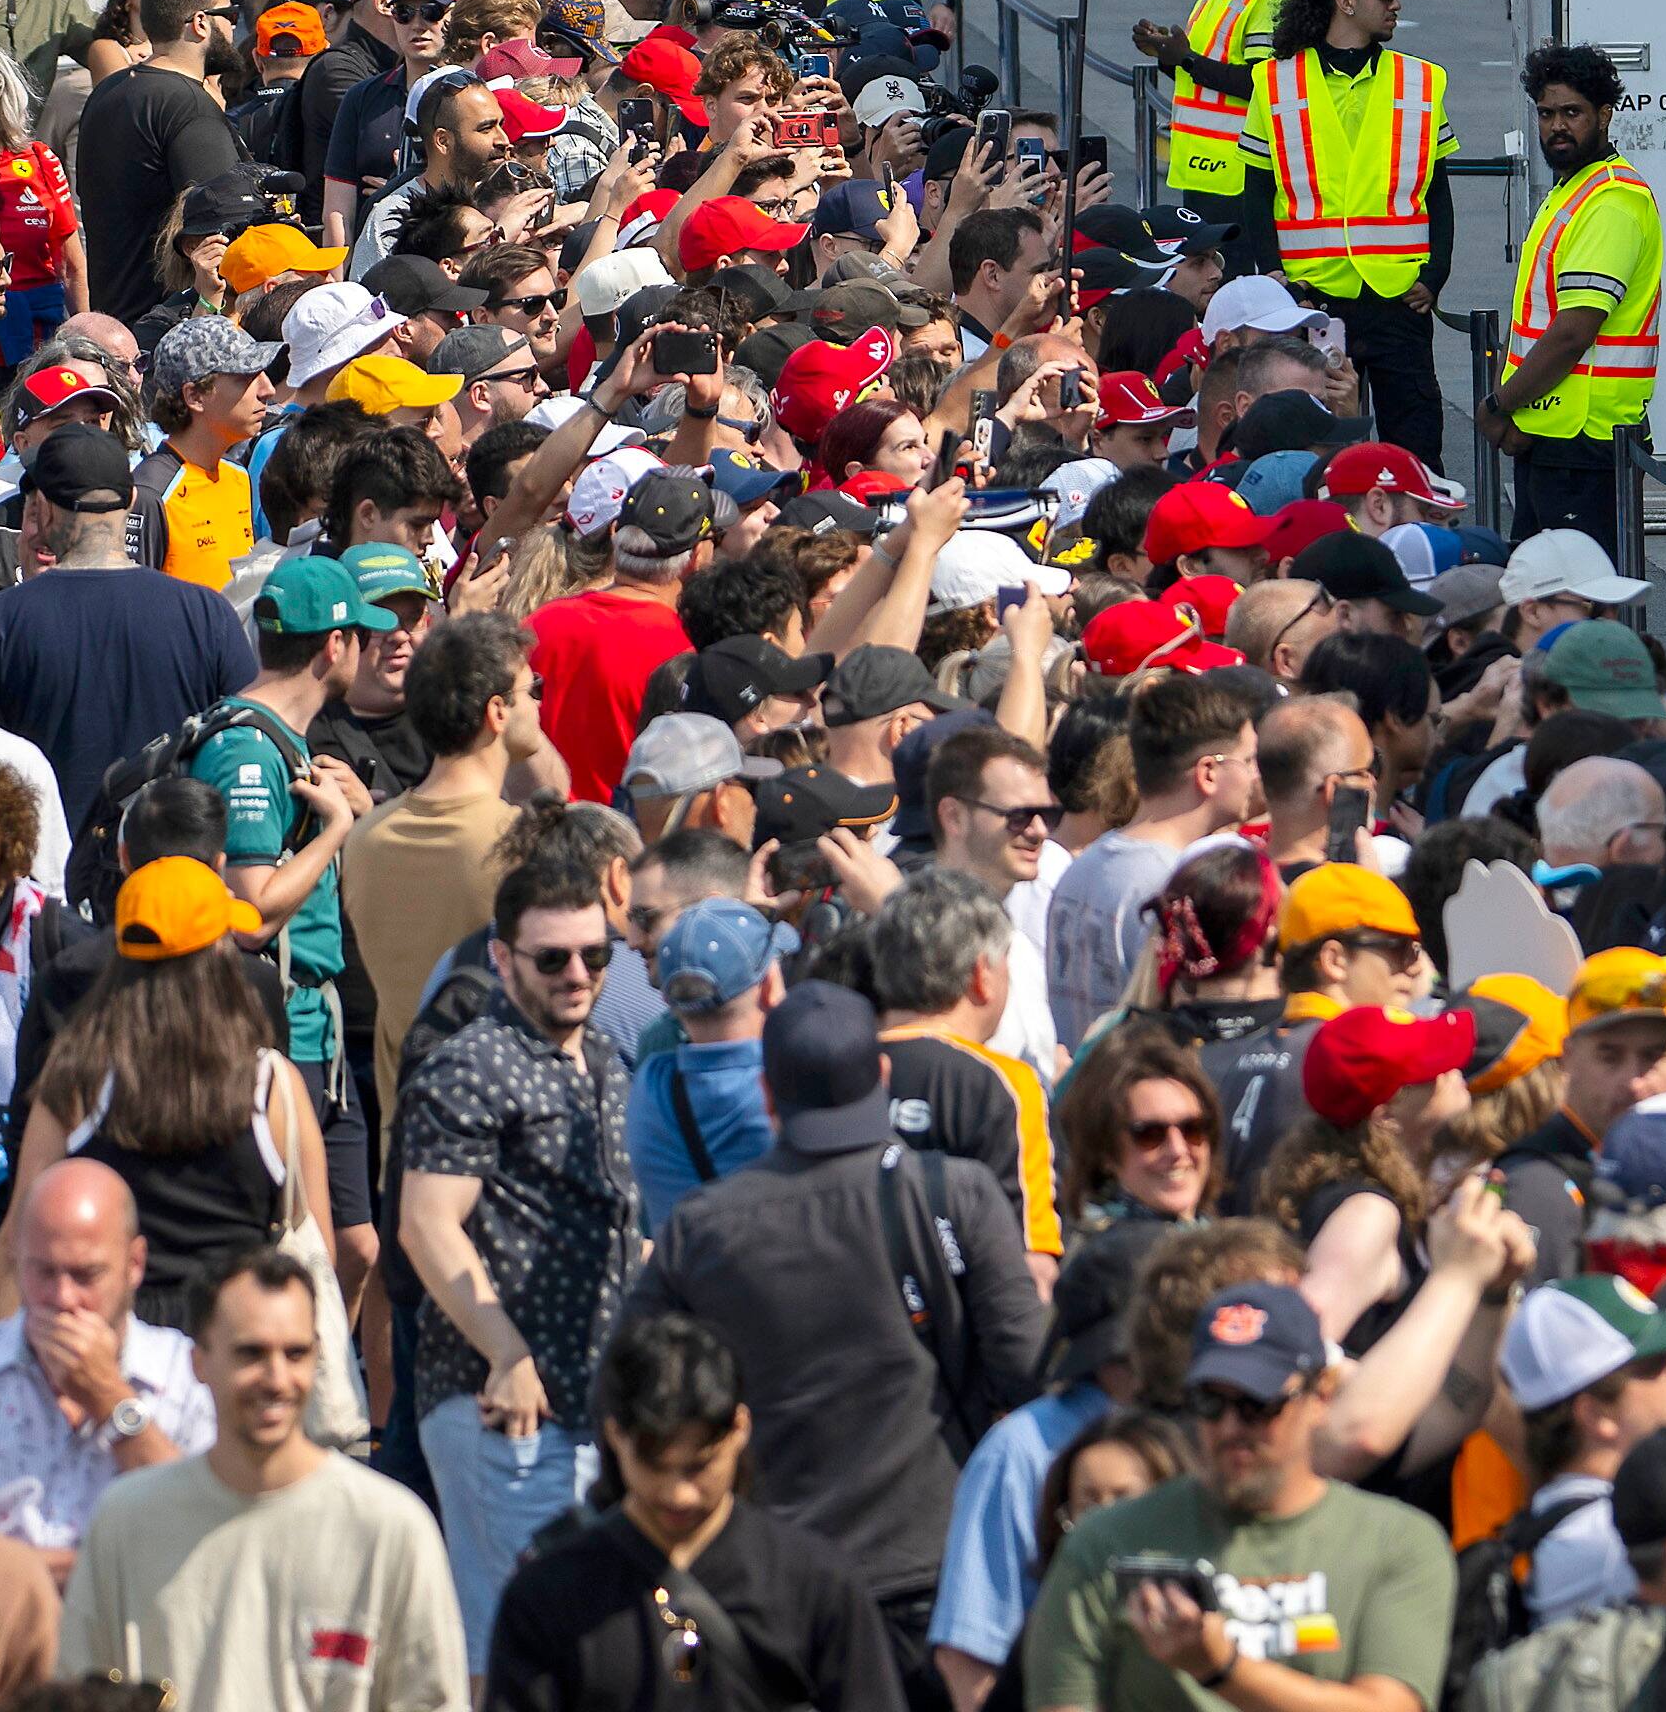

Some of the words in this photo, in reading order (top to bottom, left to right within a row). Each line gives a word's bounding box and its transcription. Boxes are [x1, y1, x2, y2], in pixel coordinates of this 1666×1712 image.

[724, 6, 756, 19] ORACLE
[869, 338, 889, 360] 44
[1231, 1074, 1264, 1142] 4
